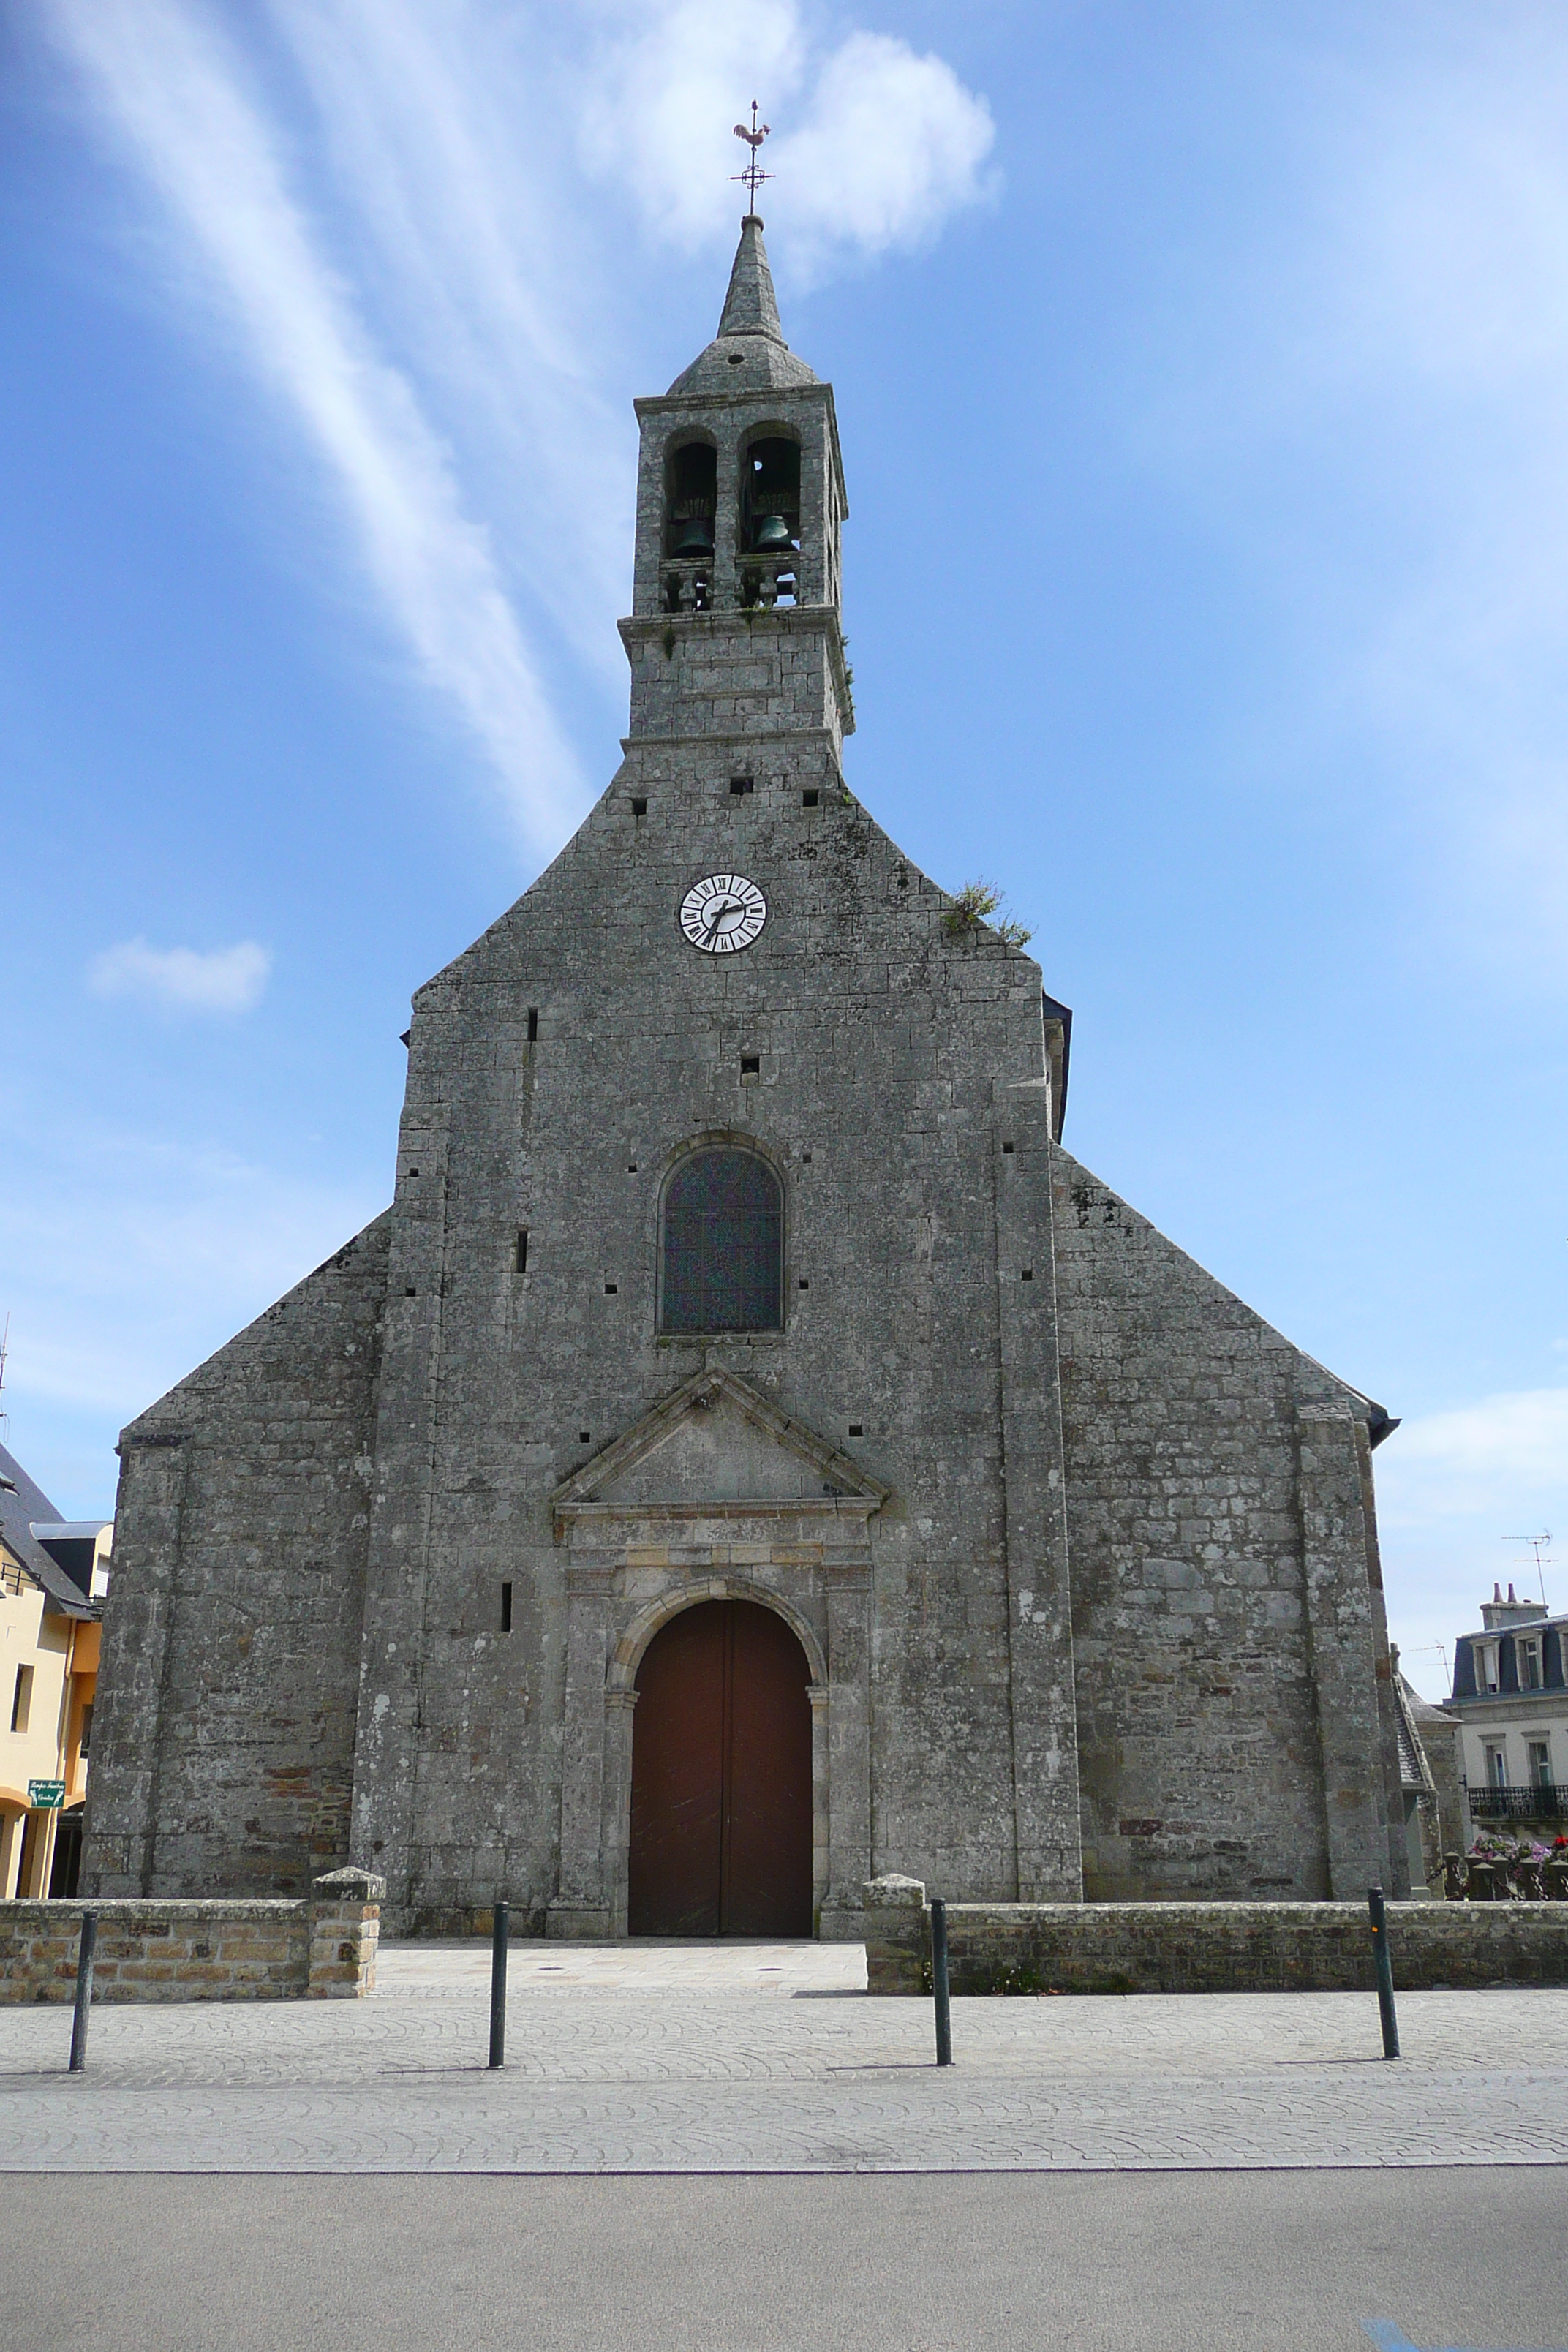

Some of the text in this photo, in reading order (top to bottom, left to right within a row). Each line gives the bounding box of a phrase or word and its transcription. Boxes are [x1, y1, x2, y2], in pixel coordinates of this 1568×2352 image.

[700, 883, 712, 896] XI
[717, 878, 726, 890] XII
[735, 881, 743, 892] I
[687, 896, 701, 906] X
[720, 938, 728, 950] VI
[737, 933, 746, 944] V
